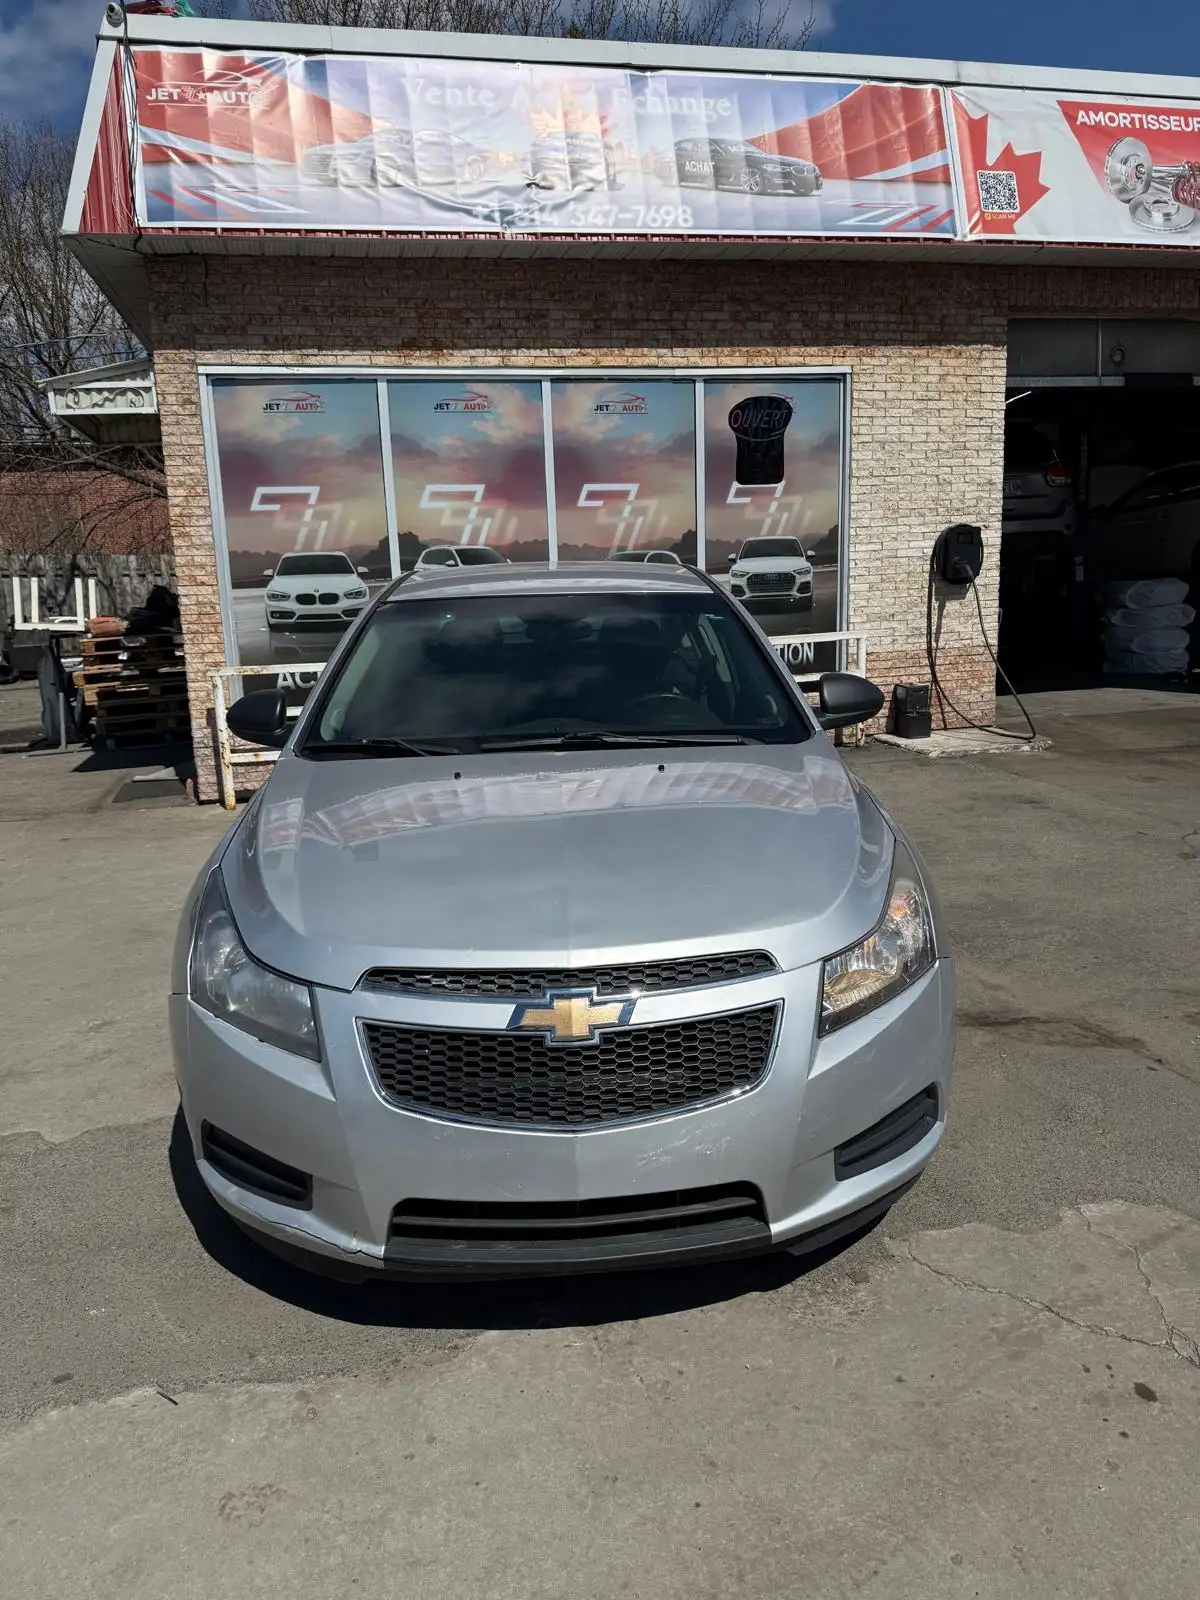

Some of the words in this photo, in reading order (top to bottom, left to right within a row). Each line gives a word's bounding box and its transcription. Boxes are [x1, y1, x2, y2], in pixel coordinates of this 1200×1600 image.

[146, 88, 181, 101] JET
[399, 78, 495, 107] Vente
[685, 160, 715, 172] ACHAT
[263, 402, 281, 411] JET
[433, 402, 450, 411] JET
[594, 404, 610, 412] JET
[731, 409, 789, 428] OUVERT
